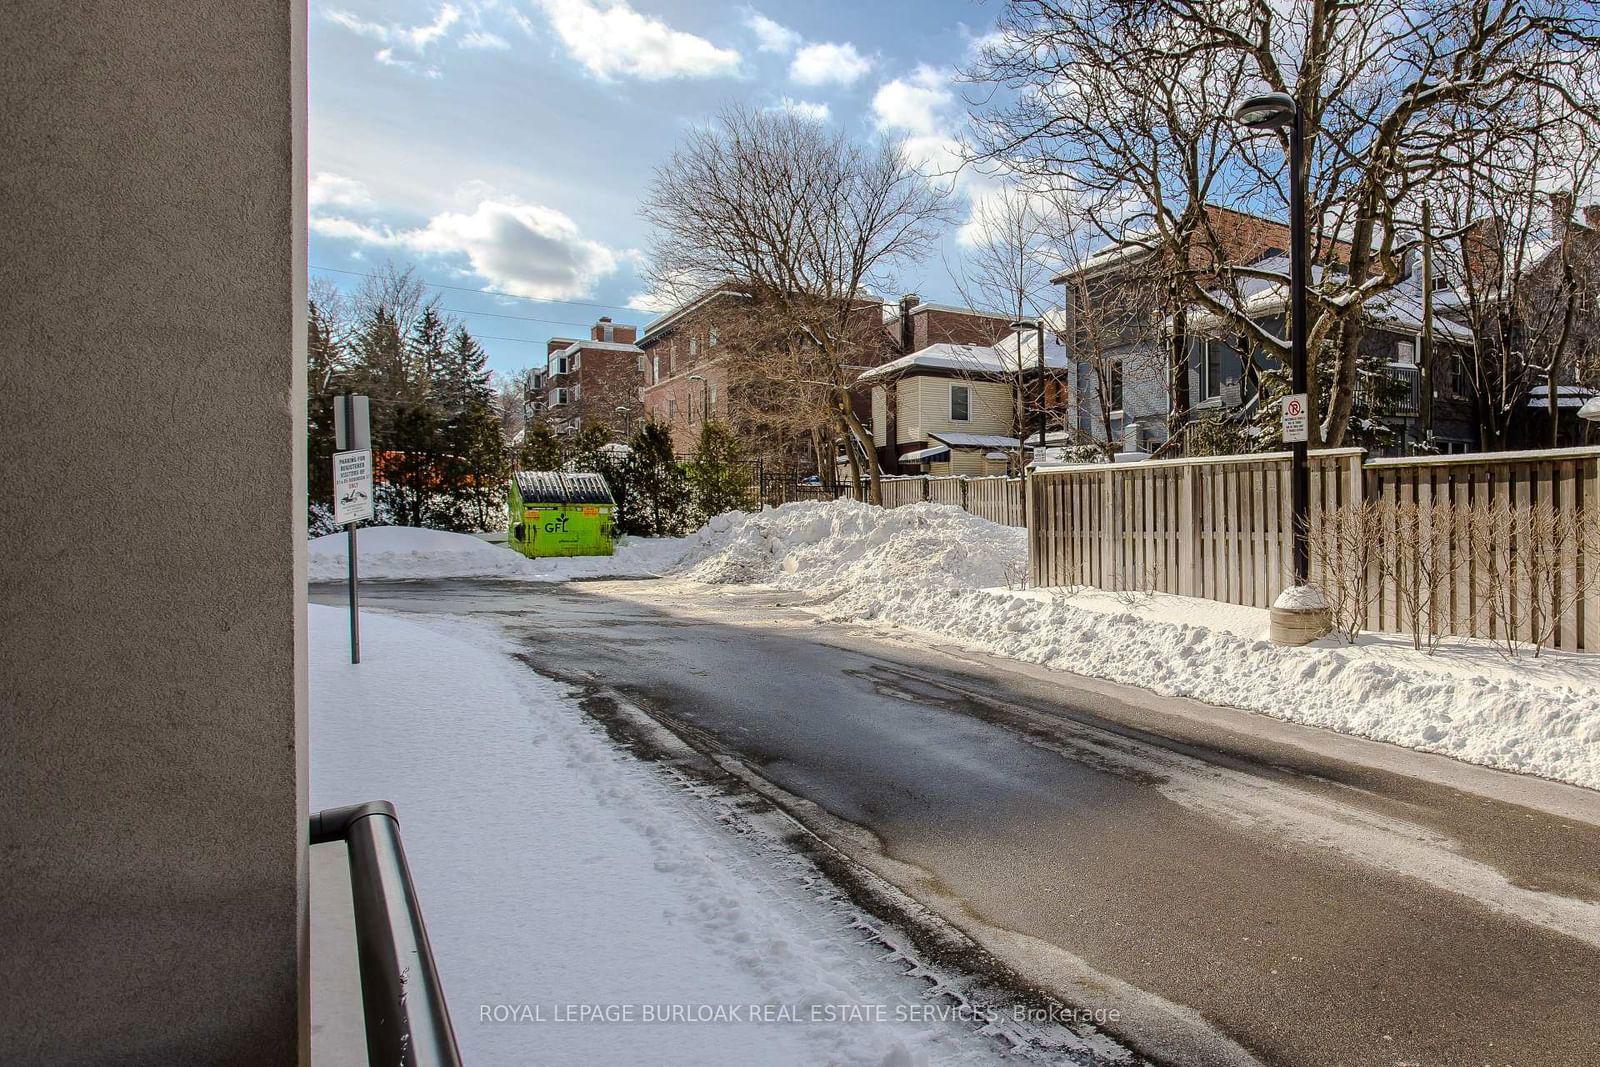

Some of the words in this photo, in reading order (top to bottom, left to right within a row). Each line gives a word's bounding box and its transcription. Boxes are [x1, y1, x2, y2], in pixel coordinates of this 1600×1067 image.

[340, 462, 365, 471] REGISTERED
[340, 470, 359, 478] VISITORS
[544, 521, 569, 533] GFL
